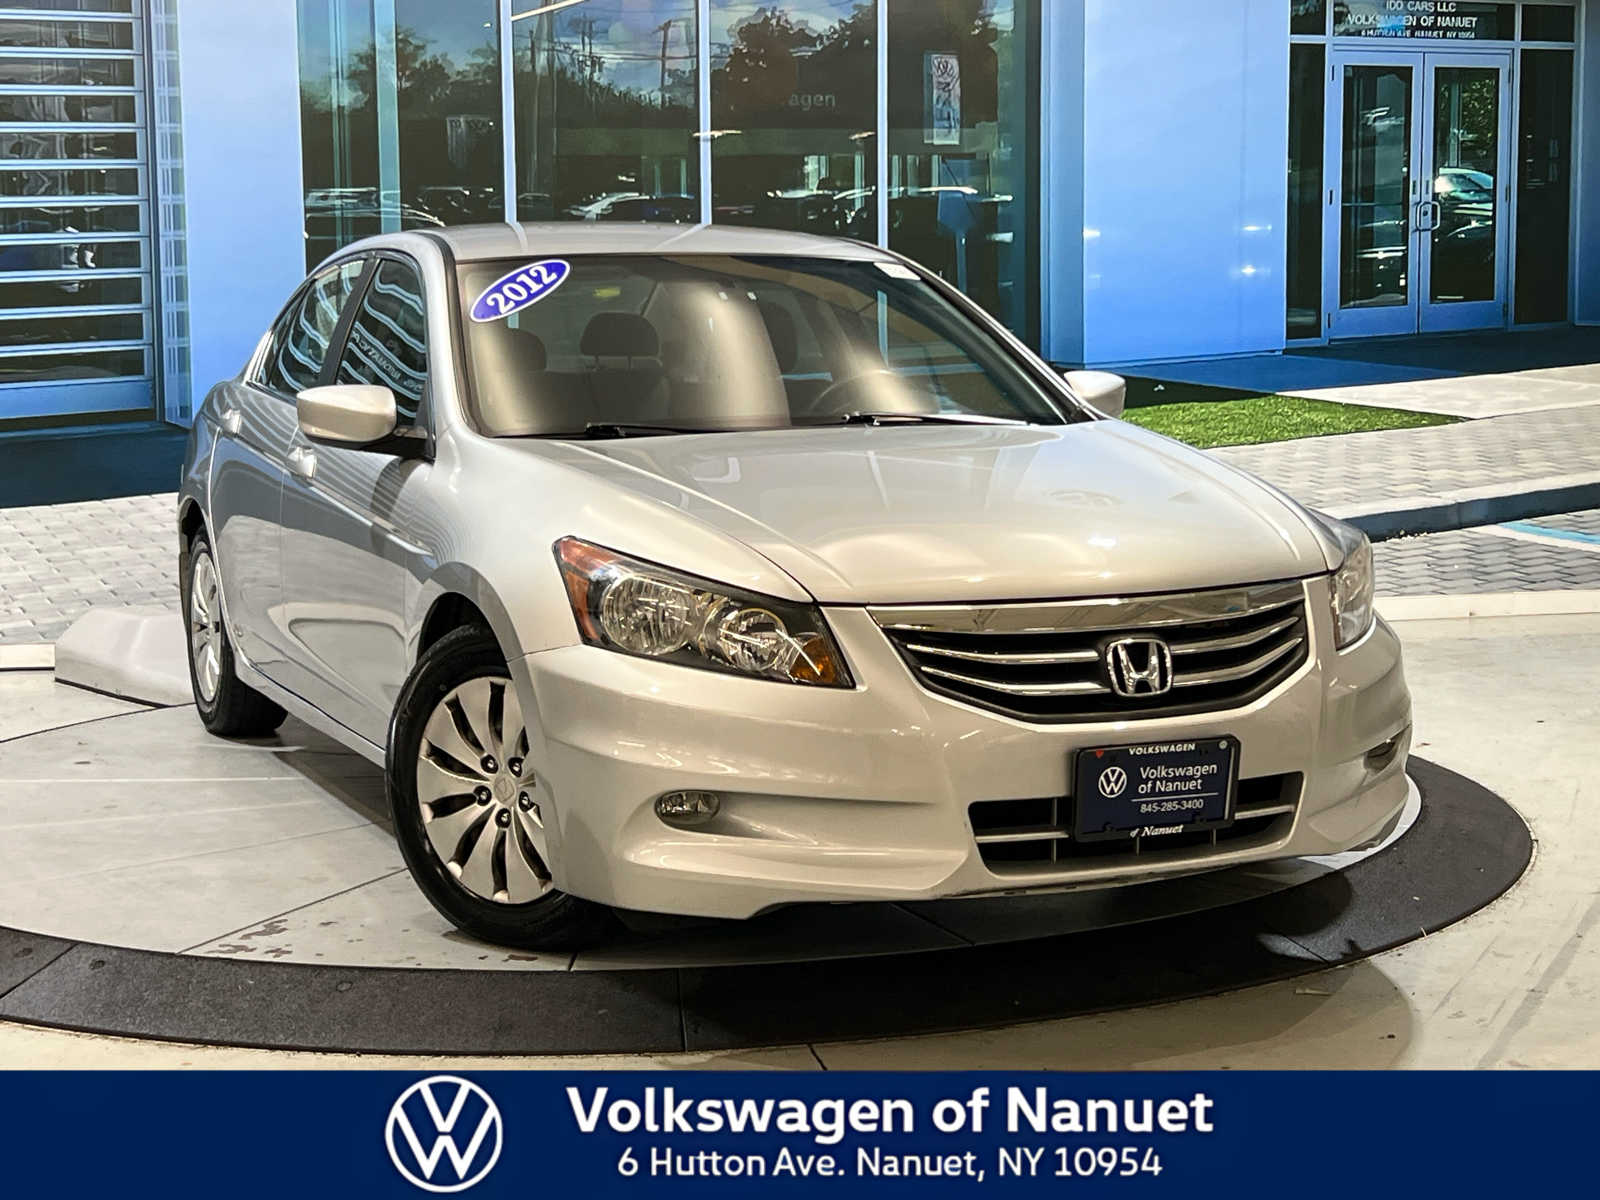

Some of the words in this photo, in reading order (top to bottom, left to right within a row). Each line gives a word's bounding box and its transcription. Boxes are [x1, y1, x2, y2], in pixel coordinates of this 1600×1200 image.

[1407, 1, 1434, 12] CARS
[1437, 2, 1456, 12] LLC
[1347, 14, 1417, 26] VOLKSWEN
[1420, 15, 1434, 26] OF
[1437, 16, 1477, 28] NANUET
[486, 265, 558, 314] 2012
[1129, 743, 1196, 756] VOLKSWAGEN
[1140, 763, 1217, 780] Volkswagen
[1138, 783, 1151, 794] of
[1155, 779, 1203, 793] Nanuet
[1140, 799, 1204, 814] 845-285-3400
[1141, 824, 1184, 837] Nanuet
